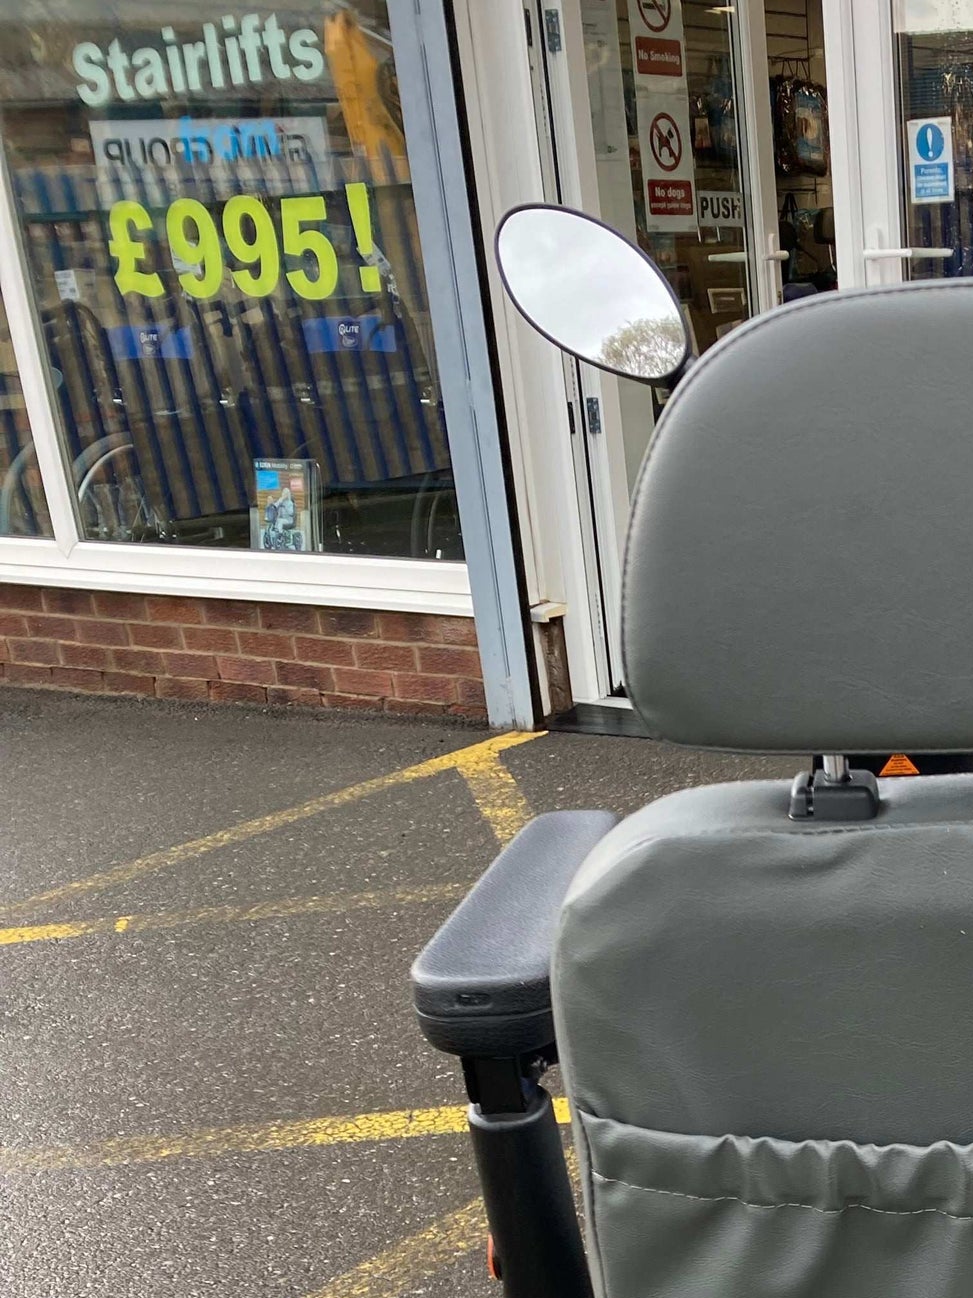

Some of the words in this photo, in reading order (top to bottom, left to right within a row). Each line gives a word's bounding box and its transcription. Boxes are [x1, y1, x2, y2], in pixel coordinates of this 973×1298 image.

[73, 12, 325, 107] Stairlifts
[638, 49, 649, 60] No
[650, 50, 681, 65] Smoking
[655, 186, 666, 197] No
[667, 186, 685, 199] dogs
[699, 196, 741, 219] PUSH
[108, 182, 381, 300] £995!
